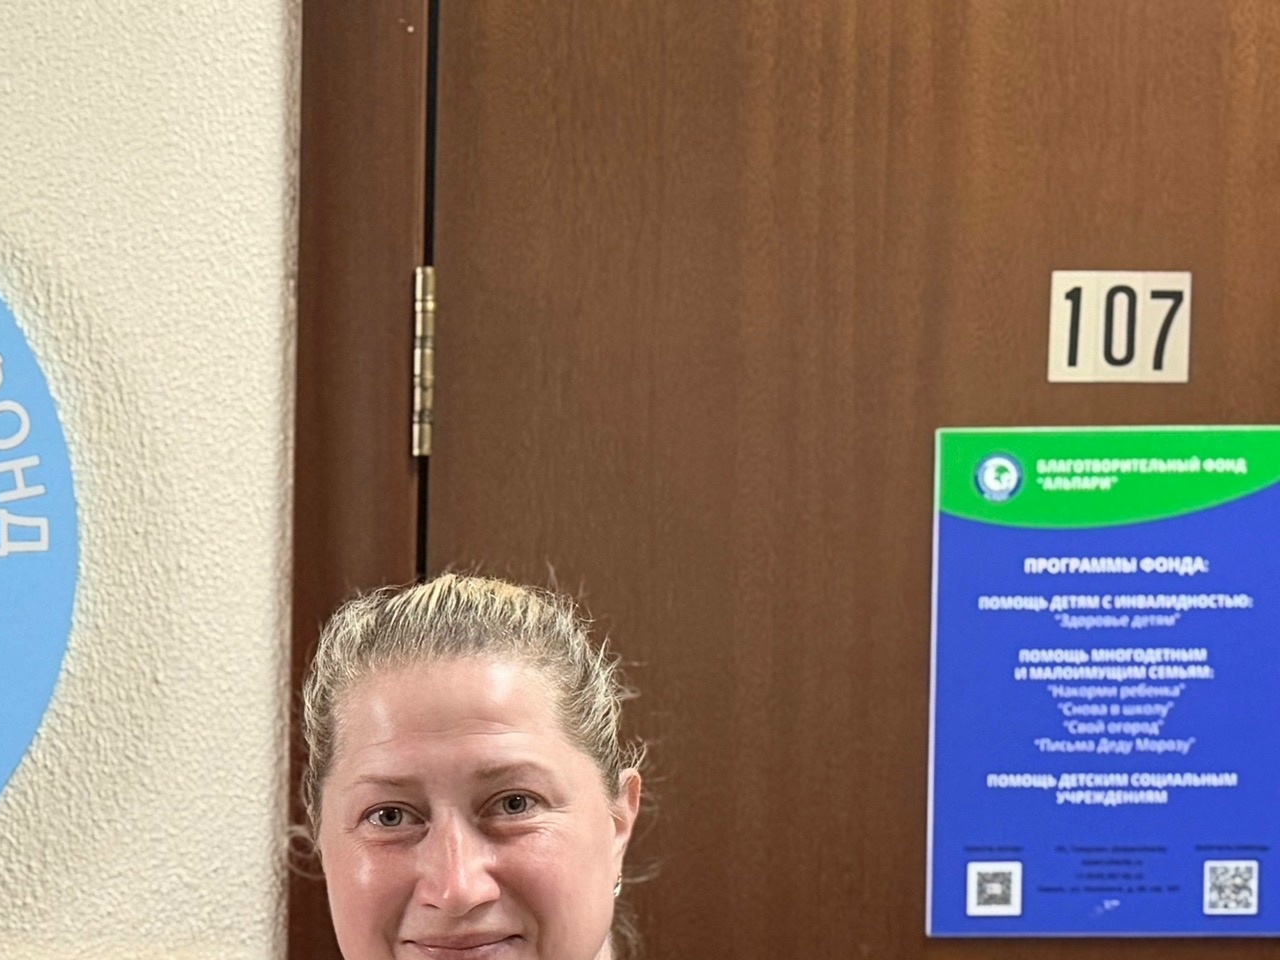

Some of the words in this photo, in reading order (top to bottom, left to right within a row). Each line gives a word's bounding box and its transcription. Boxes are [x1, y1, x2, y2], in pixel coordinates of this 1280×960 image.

[1064, 285, 1185, 371] 107
[1036, 456, 1201, 474] БЛАГОТВОРИТЕЛЬНЫЙ
[1203, 458, 1248, 474] ФОНД
[1024, 557, 1137, 574] ПРОГРАММЫ
[1139, 556, 1209, 575] ФОНДА:
[978, 596, 1048, 611] ПОМОЩЬ
[1050, 595, 1099, 612] ДЕТЯМ
[1101, 596, 1112, 610] С
[1114, 594, 1253, 611] ИНВАЛИДНОСТЬЮ:
[1019, 649, 1089, 664] ПОМОЩЬ
[1091, 648, 1207, 664] МНОГОДЕТНЫМ
[1014, 668, 1027, 681] И
[1029, 666, 1147, 682] МАЛОИМУЩИМ
[1148, 665, 1214, 680] СЕМЬЯМ:
[987, 774, 1057, 789] ПОМОЩЬ
[1058, 773, 1128, 790] ДЕТСКИМ
[1131, 772, 1238, 788] СОЦИАЛЬНЫМ
[1056, 790, 1168, 806] УЧРЕЖДЕНИЯМ
